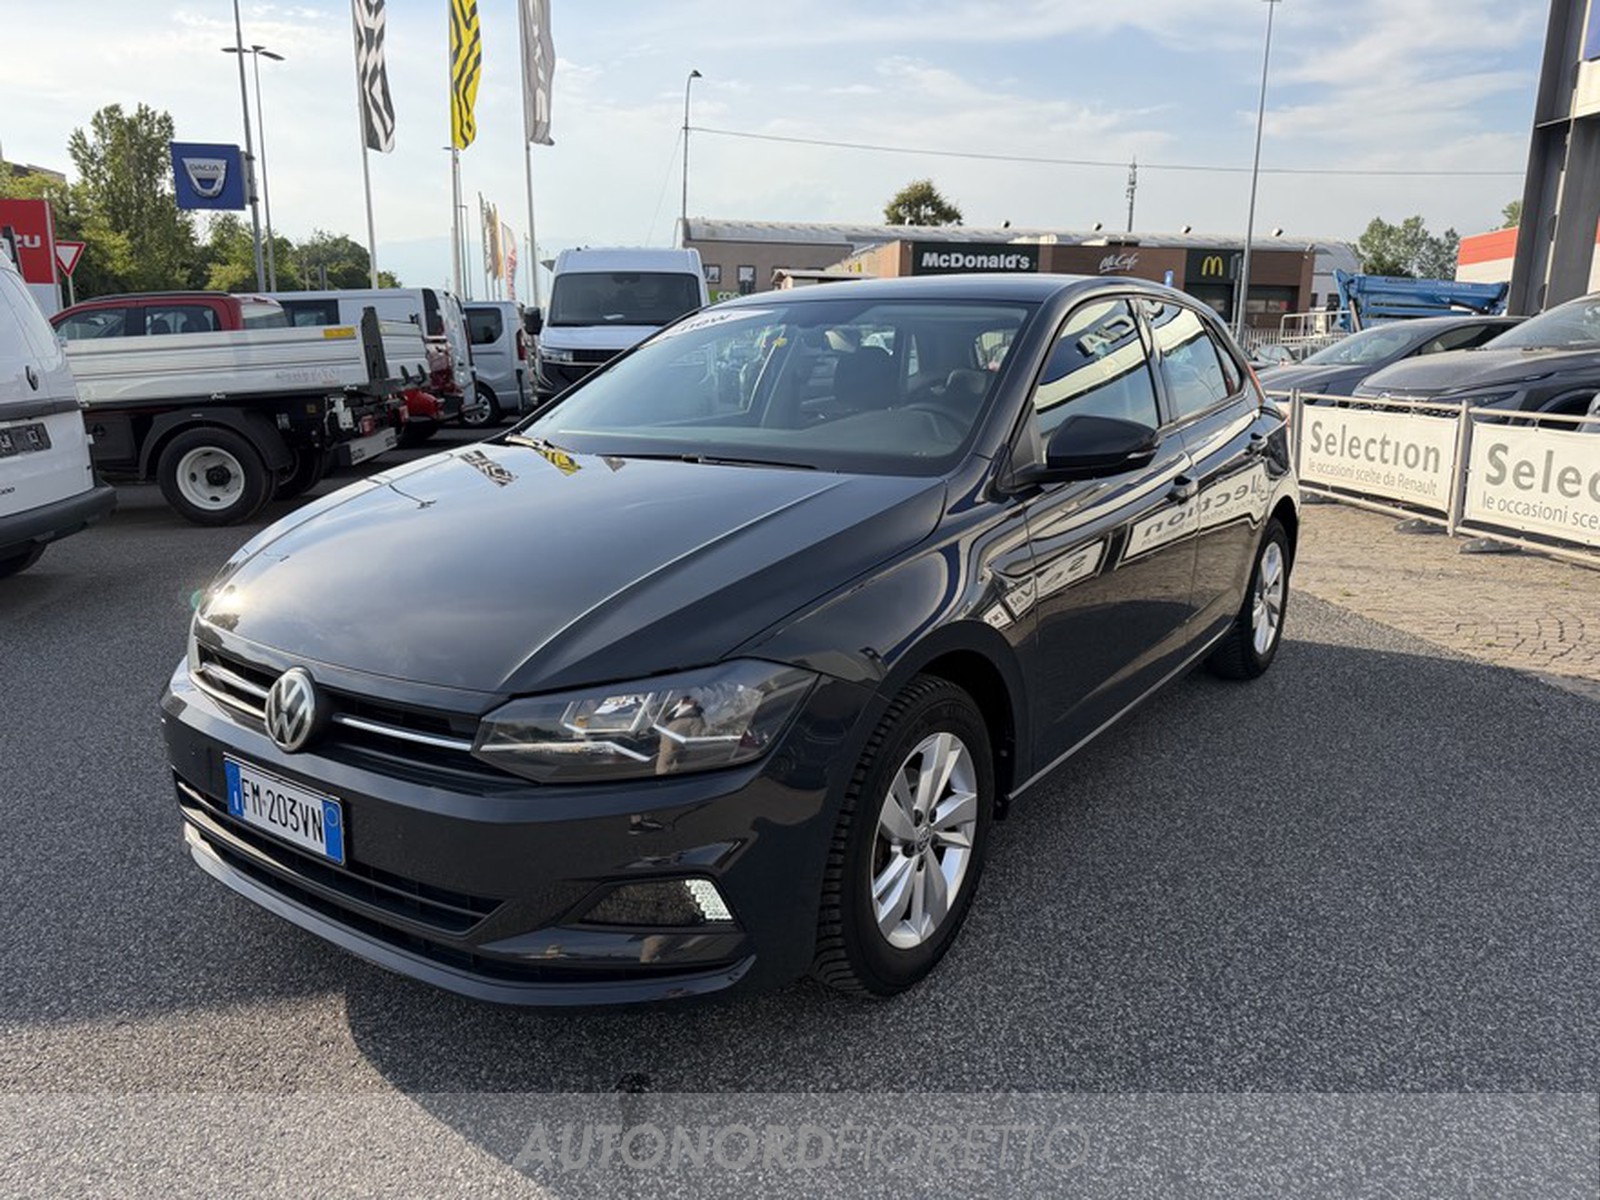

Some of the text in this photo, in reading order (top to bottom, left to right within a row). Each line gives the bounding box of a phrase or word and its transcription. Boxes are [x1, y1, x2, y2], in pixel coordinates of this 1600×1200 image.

[921, 252, 1030, 270] McDonald's
[1310, 420, 1441, 474] Selection
[1316, 461, 1354, 479] occasioni
[1356, 465, 1382, 485] scelte
[1383, 470, 1395, 486] da
[1397, 473, 1438, 496] Renault
[1482, 490, 1495, 510] le
[1497, 498, 1569, 524] occasioni
